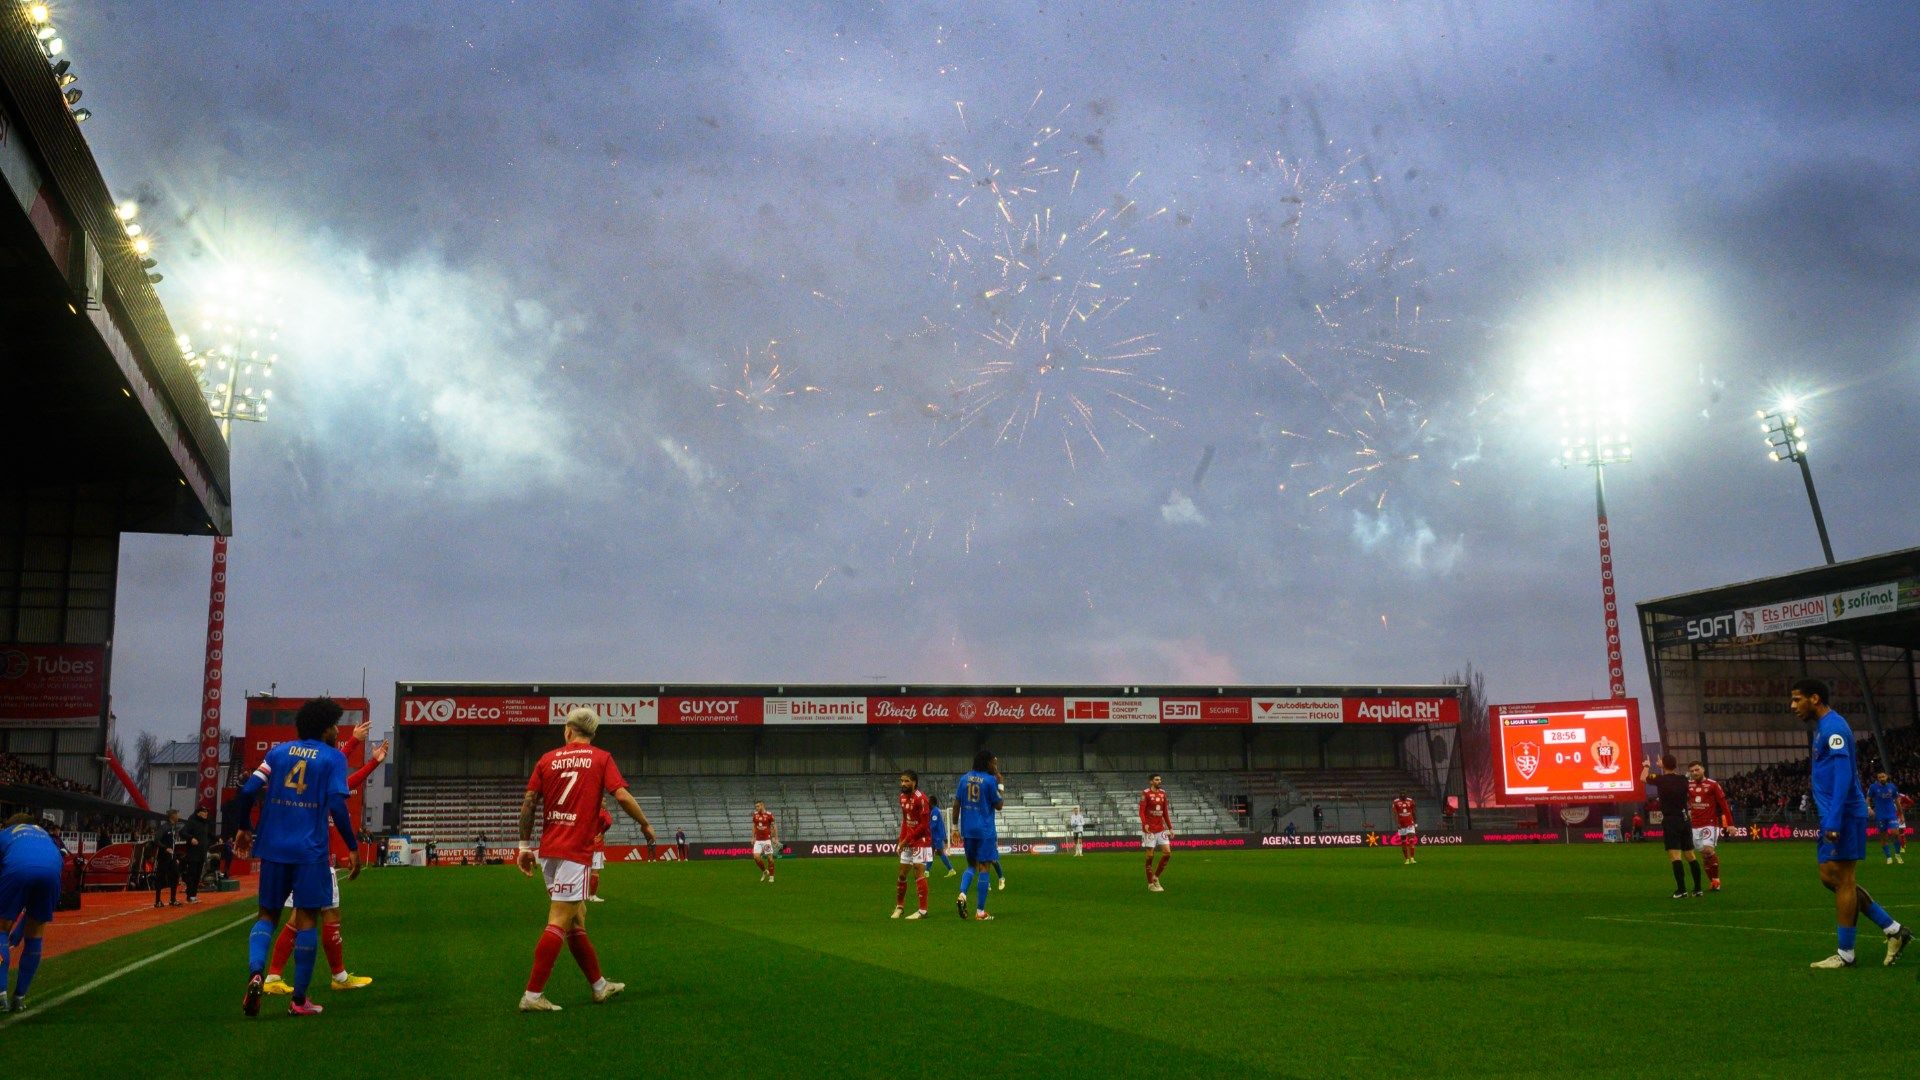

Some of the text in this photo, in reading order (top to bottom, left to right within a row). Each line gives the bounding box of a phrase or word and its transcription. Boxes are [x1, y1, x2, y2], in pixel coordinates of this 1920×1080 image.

[1762, 600, 1824, 622] Ets PICHON
[1686, 615, 1734, 640] SOFT
[33, 655, 94, 674] Tubes
[404, 698, 456, 723] IXO
[456, 704, 500, 719] DÉCO
[553, 703, 636, 717] KOTUM
[679, 700, 740, 714] GUYOT
[791, 701, 864, 714] bihannic
[875, 700, 949, 720] Breizh Cola
[984, 700, 1056, 720] Breizh Cola
[1357, 700, 1412, 723] Aquila
[680, 713, 738, 722] environnement
[1309, 712, 1340, 720] FICHOU
[1551, 732, 1576, 741] 28:56
[288, 745, 319, 760] DANTE
[551, 756, 592, 770] SATRIANO
[284, 759, 308, 795] 4
[560, 771, 579, 805] 7
[966, 783, 980, 803] 19
[1262, 836, 1301, 846] AGENCE
[1303, 835, 1317, 845] DE
[1318, 834, 1362, 846] VOYAGES
[492, 848, 515, 857] MEDIA
[811, 844, 856, 855] AGENCE
[858, 844, 873, 854] DE
